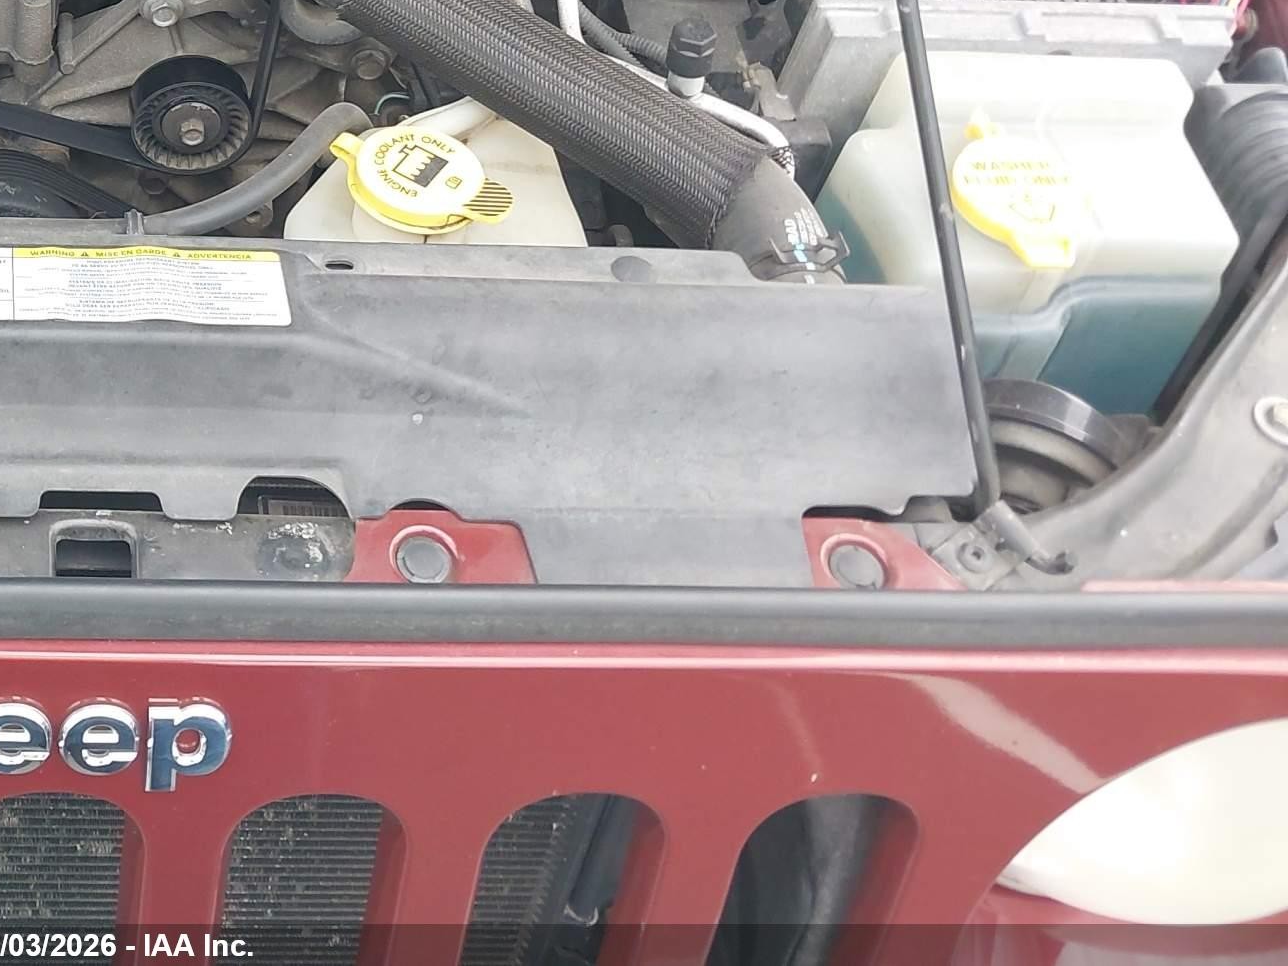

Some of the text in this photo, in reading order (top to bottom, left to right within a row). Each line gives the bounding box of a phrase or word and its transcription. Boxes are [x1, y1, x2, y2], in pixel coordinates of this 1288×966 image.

[374, 133, 456, 198] ENGINE COOLANT ONLY
[29, 250, 76, 258] WARNING
[135, 248, 168, 256] GARDE
[187, 252, 252, 260] ADVERTENCIA
